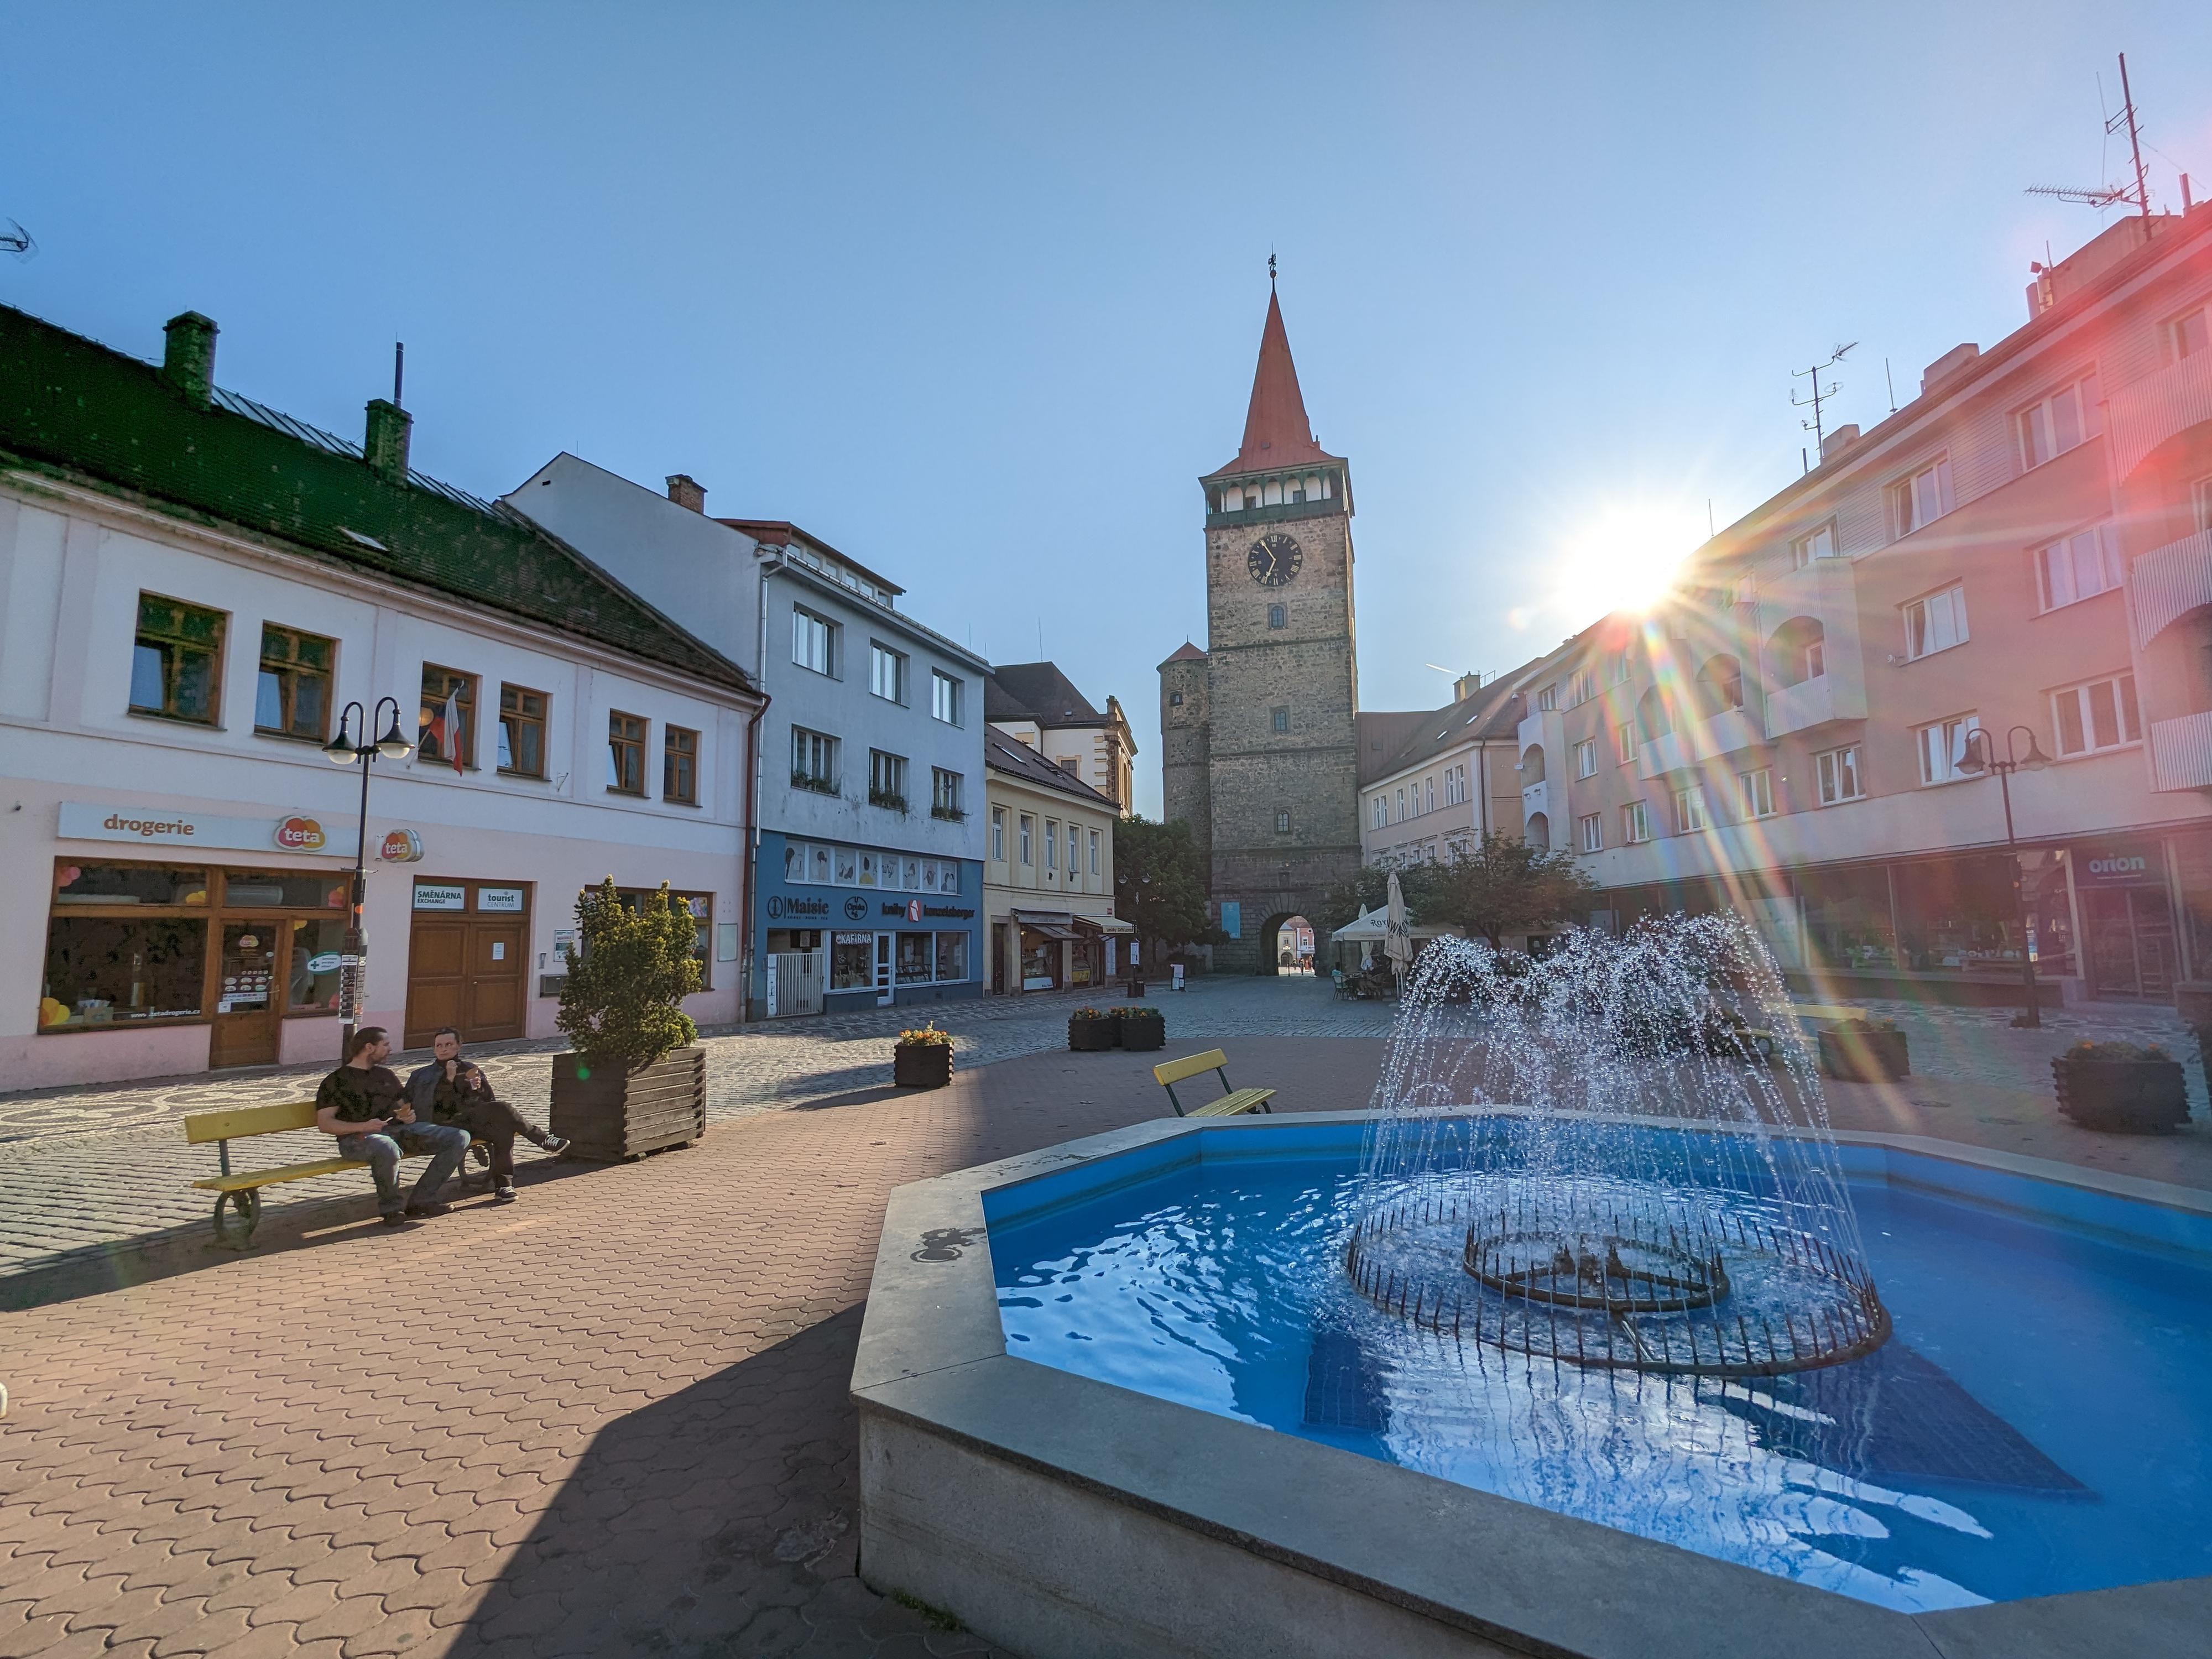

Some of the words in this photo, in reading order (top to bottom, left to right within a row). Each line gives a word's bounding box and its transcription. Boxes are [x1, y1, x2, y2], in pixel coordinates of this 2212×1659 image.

[104, 813, 194, 837] drogerie
[285, 828, 320, 843] teta
[385, 842, 408, 854] teta
[2089, 852, 2145, 873] orion
[417, 890, 462, 899] SMĚNÁRNA
[487, 891, 514, 902] tourist
[787, 897, 830, 915] Maisie
